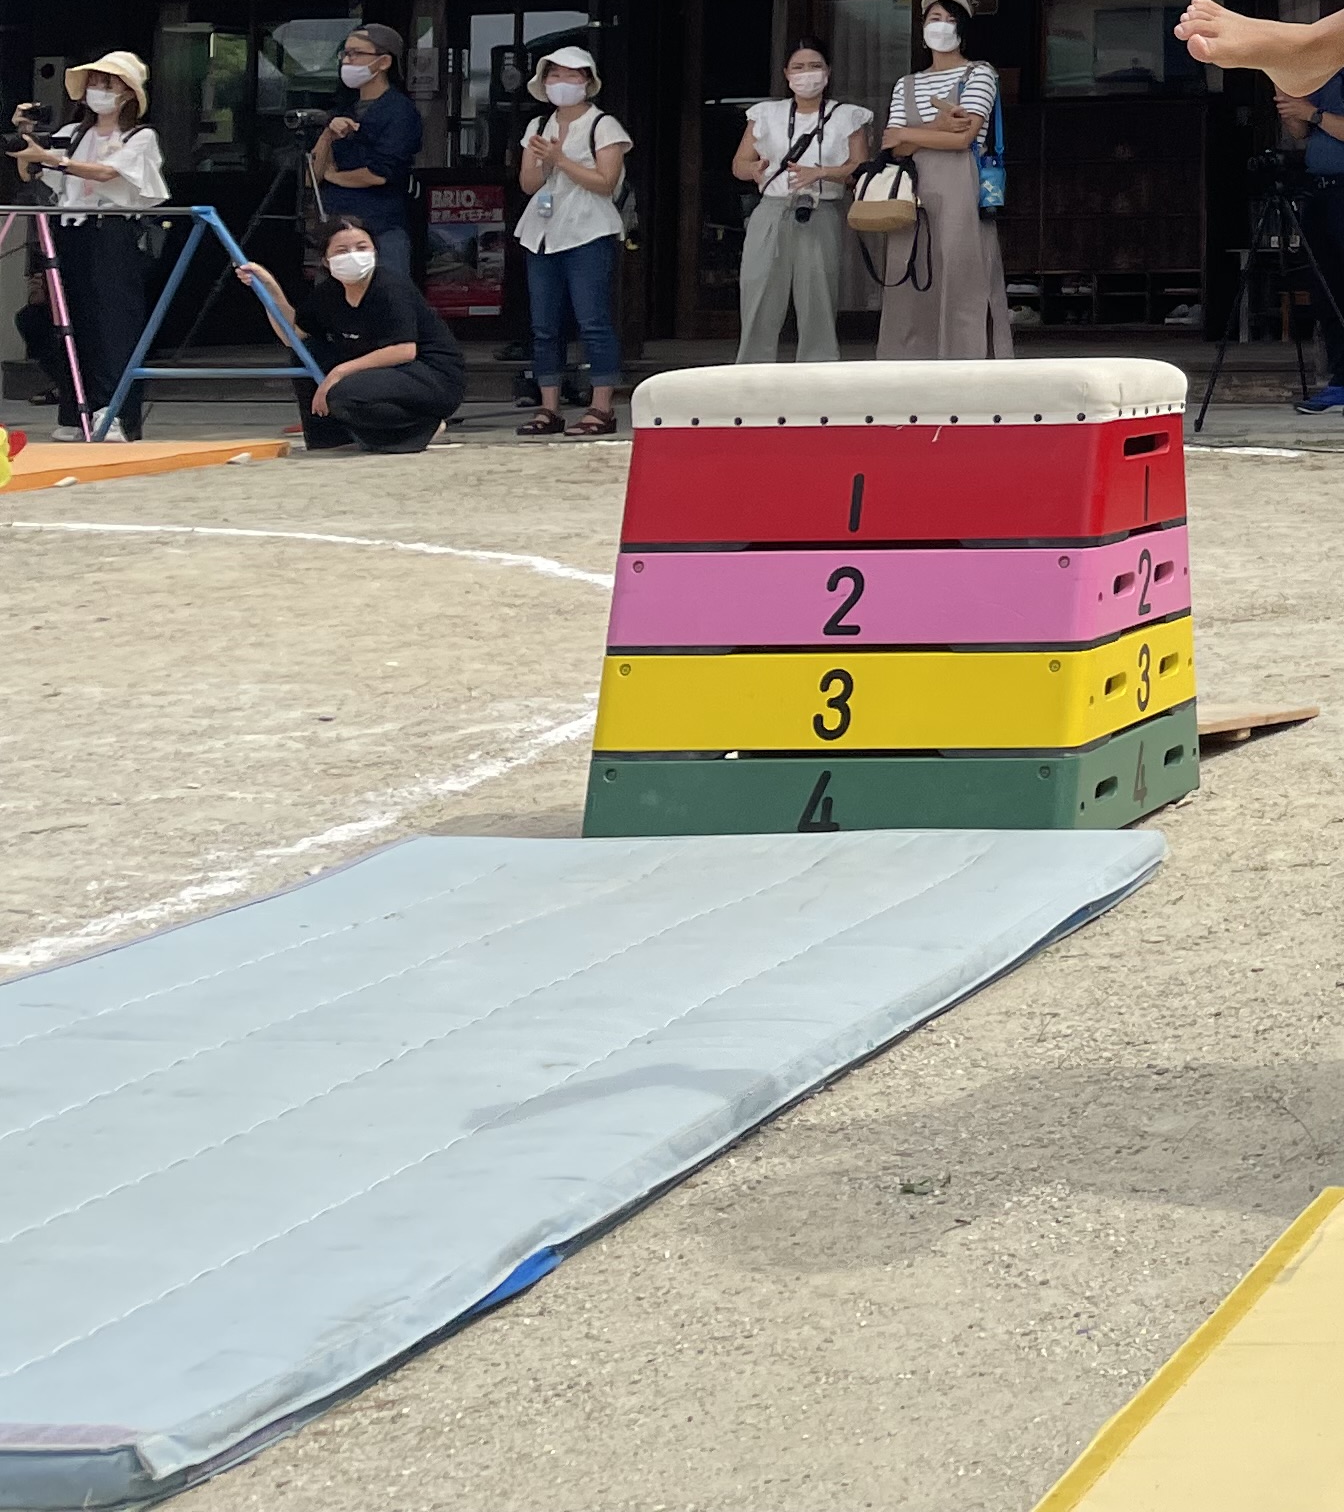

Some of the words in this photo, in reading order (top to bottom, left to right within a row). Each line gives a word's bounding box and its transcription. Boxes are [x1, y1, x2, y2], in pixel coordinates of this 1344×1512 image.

[431, 190, 476, 207] BRIO
[849, 473, 865, 533] 1
[822, 566, 865, 636] 2
[1137, 548, 1152, 617] 2
[812, 668, 854, 741] 3
[1136, 643, 1151, 713] 3
[798, 771, 840, 832] 4
[1133, 741, 1147, 808] 4
